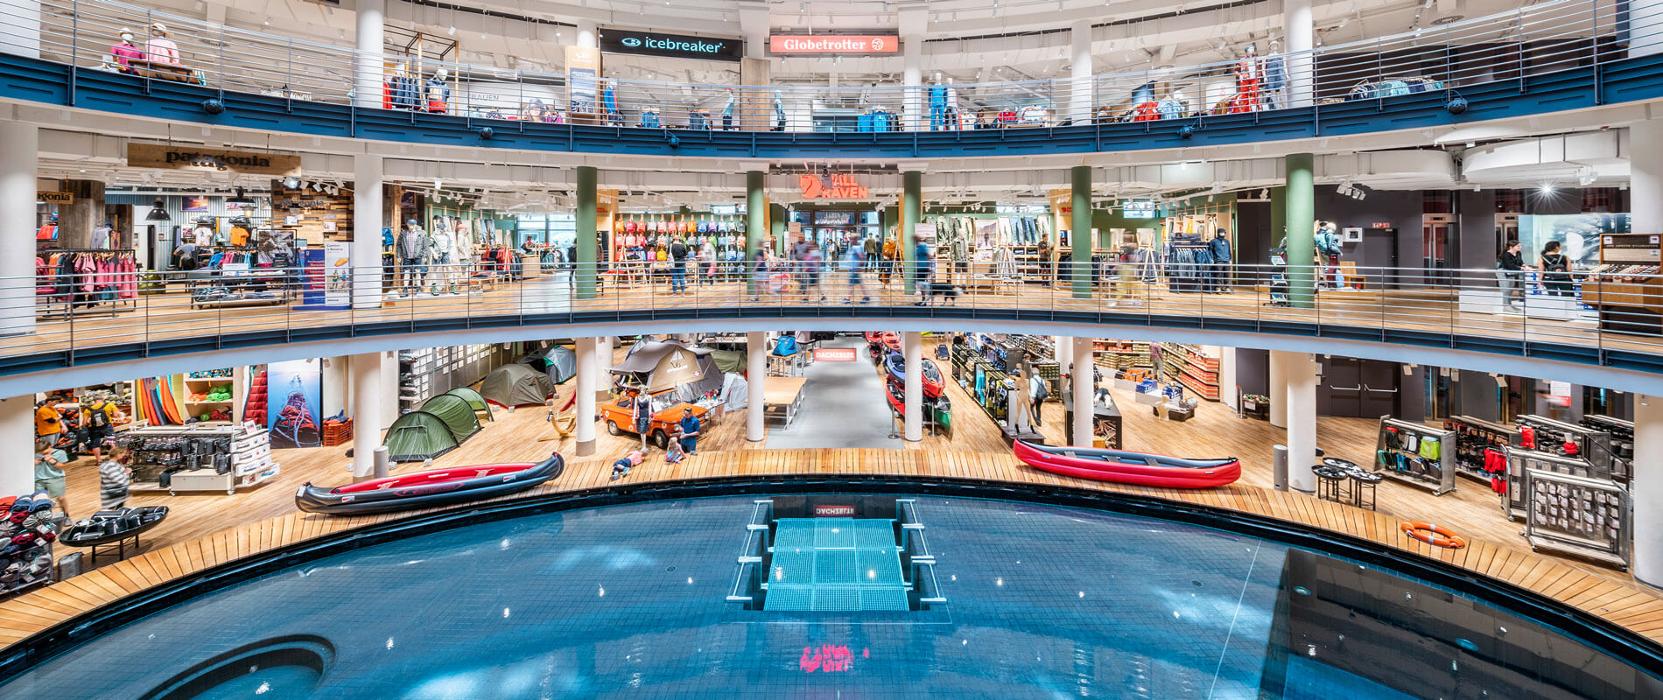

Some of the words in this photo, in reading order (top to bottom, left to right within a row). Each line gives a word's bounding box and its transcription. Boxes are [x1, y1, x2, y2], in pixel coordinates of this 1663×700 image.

[645, 36, 721, 53] icebreaker
[783, 39, 866, 50] Globetrotter
[166, 150, 271, 171] patagonia
